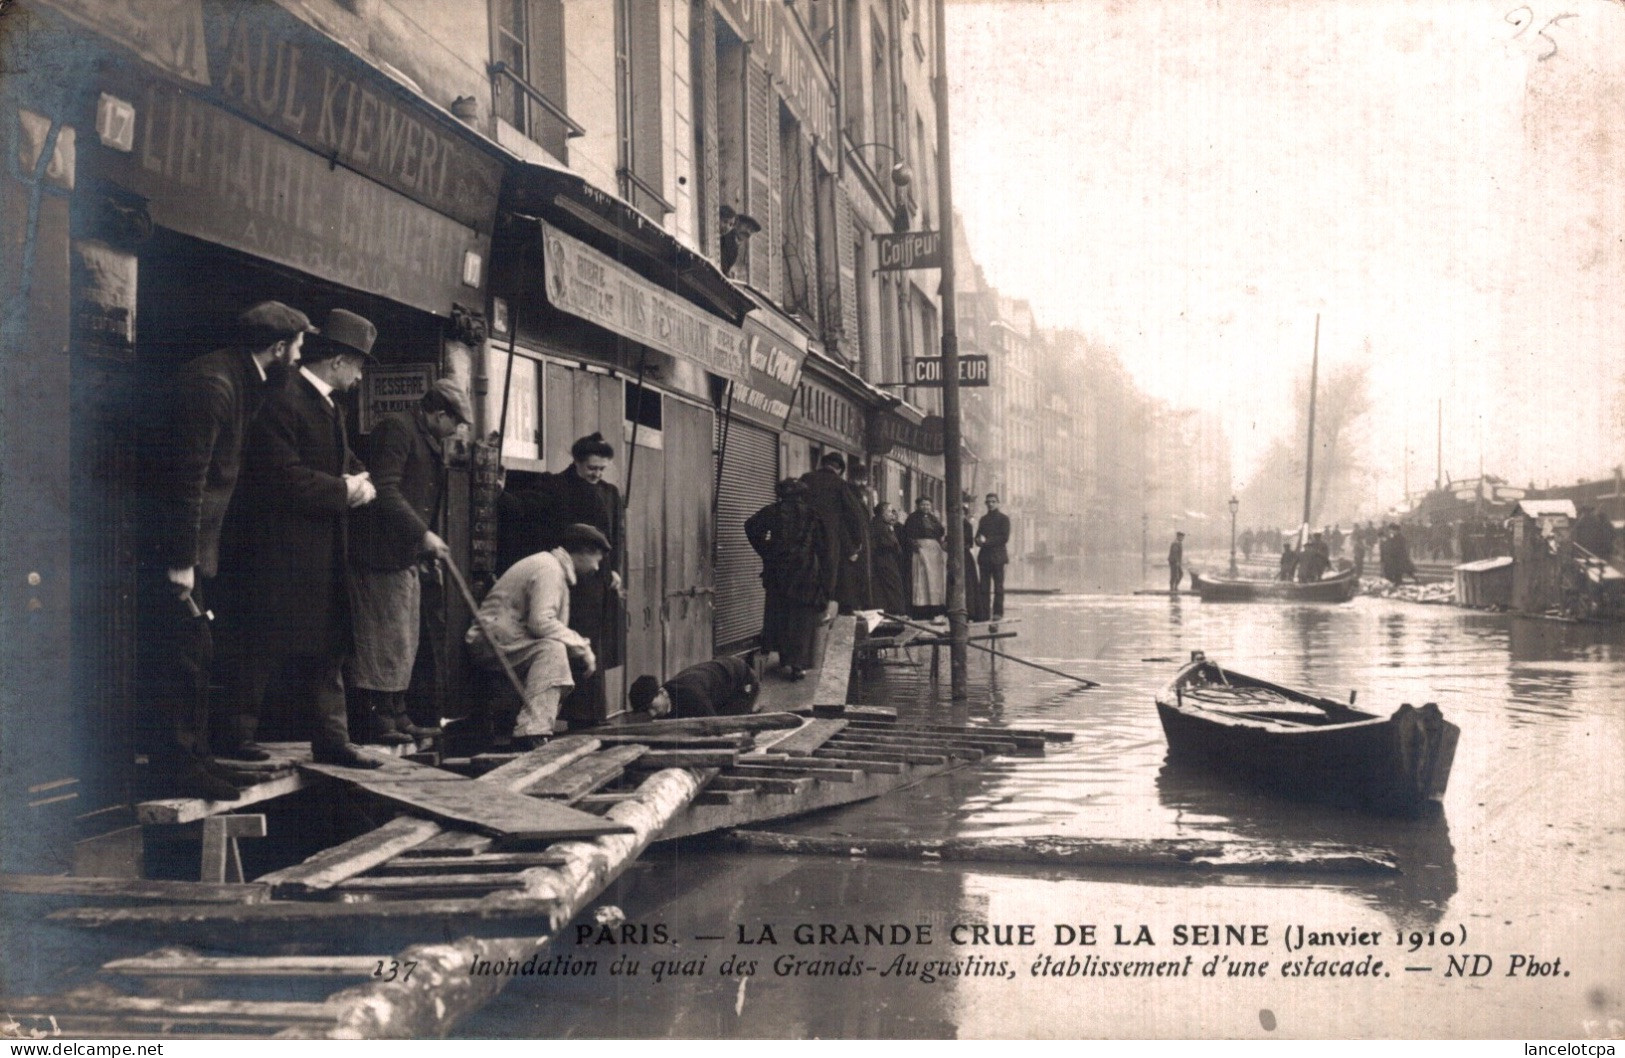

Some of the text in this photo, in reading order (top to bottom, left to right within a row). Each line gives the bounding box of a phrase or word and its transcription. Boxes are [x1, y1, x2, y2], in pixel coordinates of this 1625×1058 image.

[102, 104, 133, 143] 17
[316, 67, 454, 200] KIEWERT
[881, 234, 940, 267] Coiffeur
[916, 360, 987, 381] COIEUR
